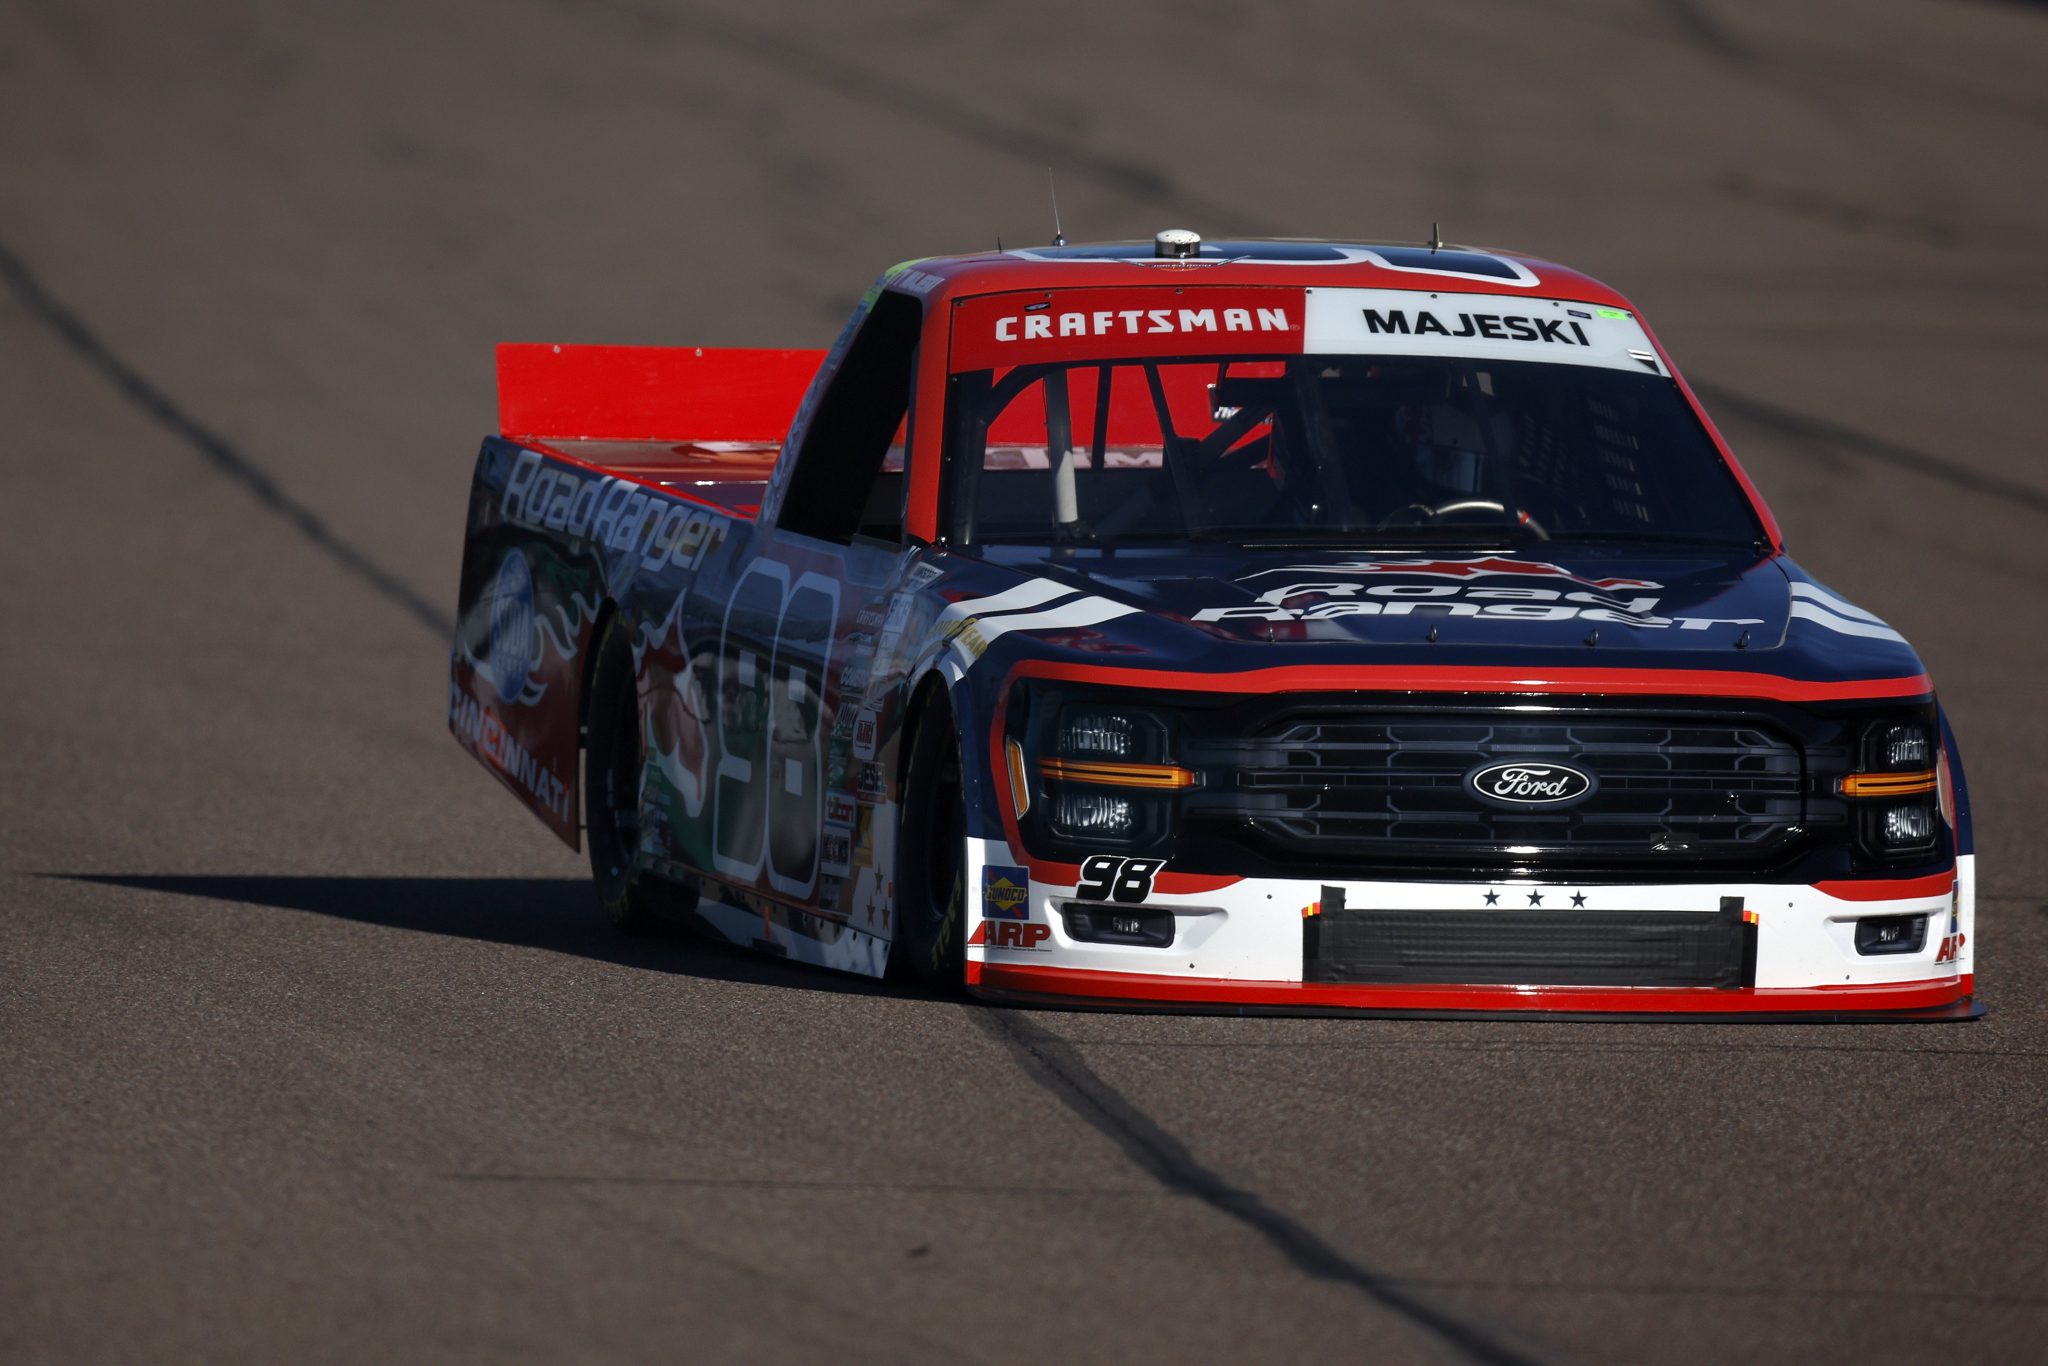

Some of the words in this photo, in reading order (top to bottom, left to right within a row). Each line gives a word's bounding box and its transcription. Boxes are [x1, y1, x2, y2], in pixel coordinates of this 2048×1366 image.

[995, 307, 1290, 342] CRAFTSMAN
[1363, 308, 1591, 347] MAJESKI
[501, 449, 614, 538] Road
[590, 478, 730, 573] Ranger
[1254, 582, 1661, 613] Road
[1190, 600, 1766, 630] Ranger
[712, 556, 841, 900] 98
[1494, 767, 1569, 796] Ford
[985, 885, 1026, 903] SUNOCO
[1075, 855, 1167, 904] 98
[967, 920, 1051, 948] ARP
